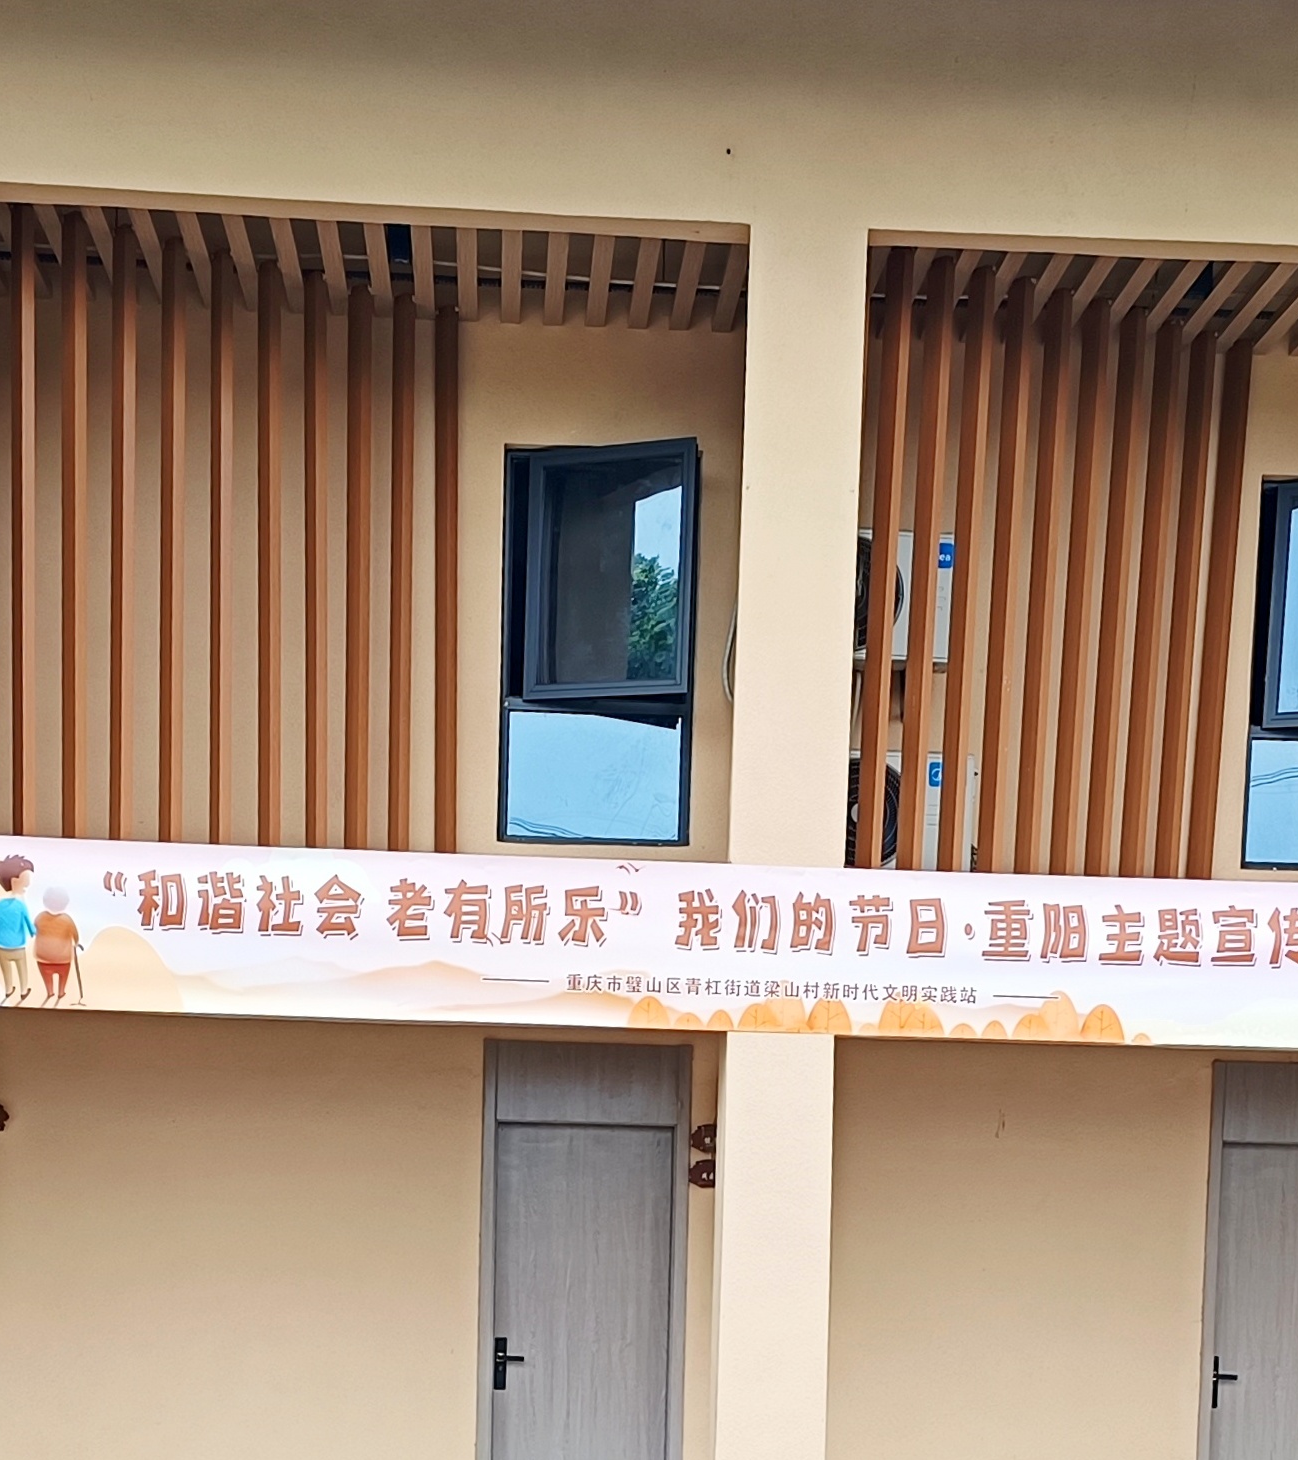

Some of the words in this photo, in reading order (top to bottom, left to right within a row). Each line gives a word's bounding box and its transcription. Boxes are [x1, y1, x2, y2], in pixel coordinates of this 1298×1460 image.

[566, 973, 978, 1004] 重庆市璧山区青杠街道梁山村新时代文明实践站
